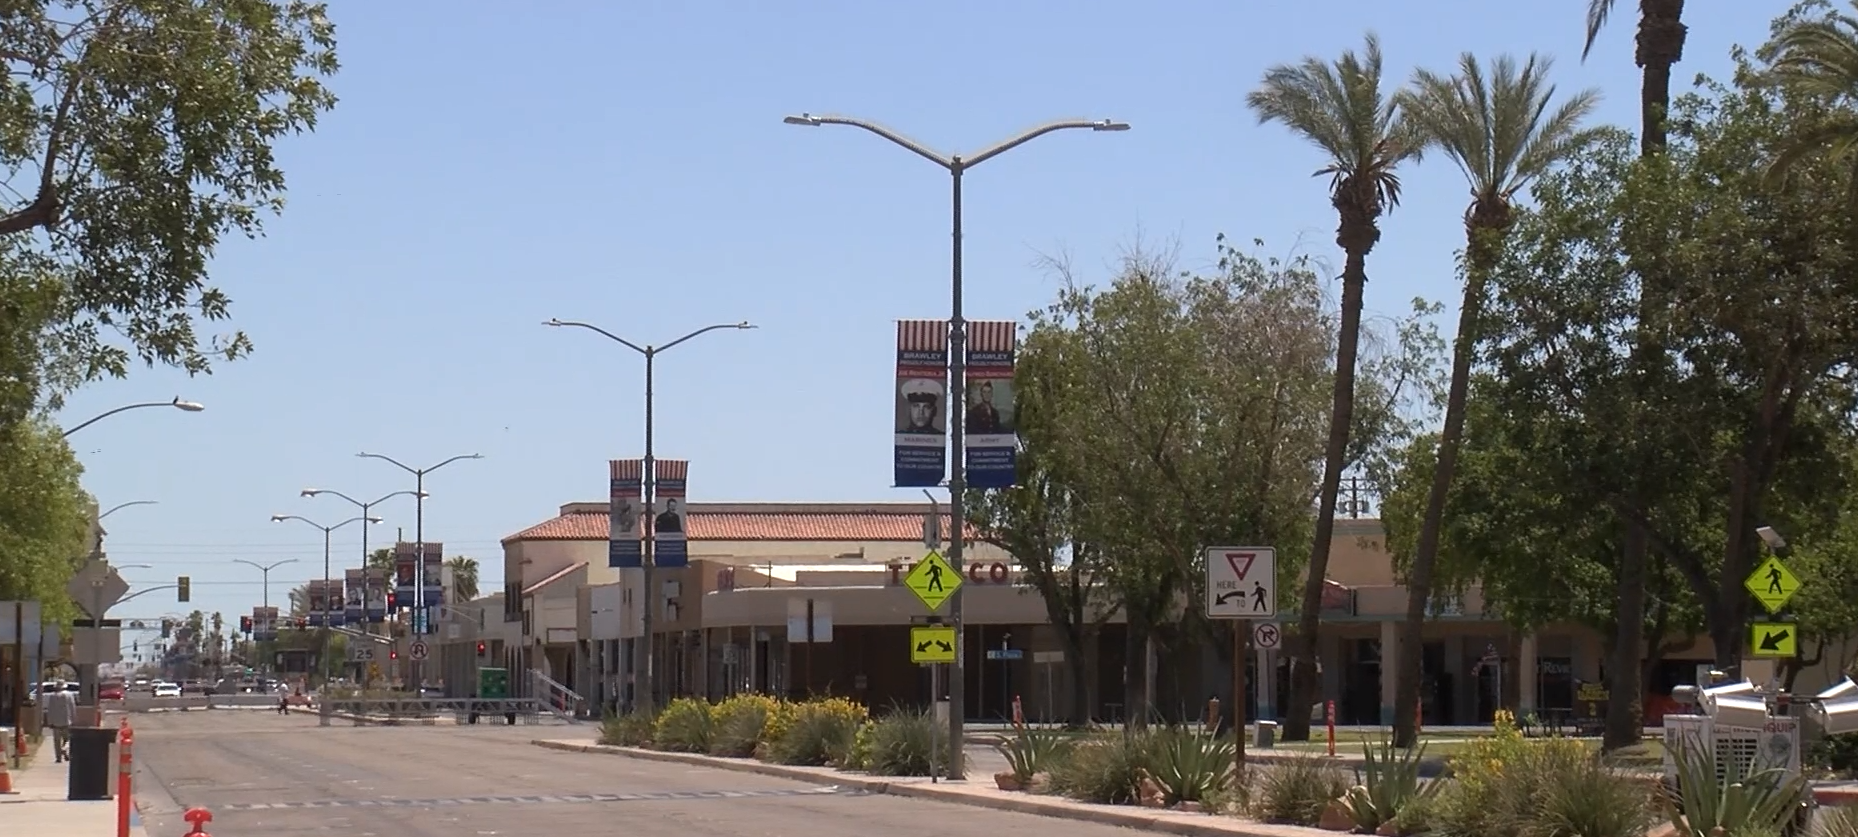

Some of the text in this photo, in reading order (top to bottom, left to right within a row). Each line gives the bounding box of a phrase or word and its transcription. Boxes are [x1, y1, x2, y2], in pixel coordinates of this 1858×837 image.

[903, 352, 941, 360] BRAWLEY
[1216, 581, 1237, 589] HERE
[1236, 599, 1246, 608] TO
[356, 649, 373, 659] 25
